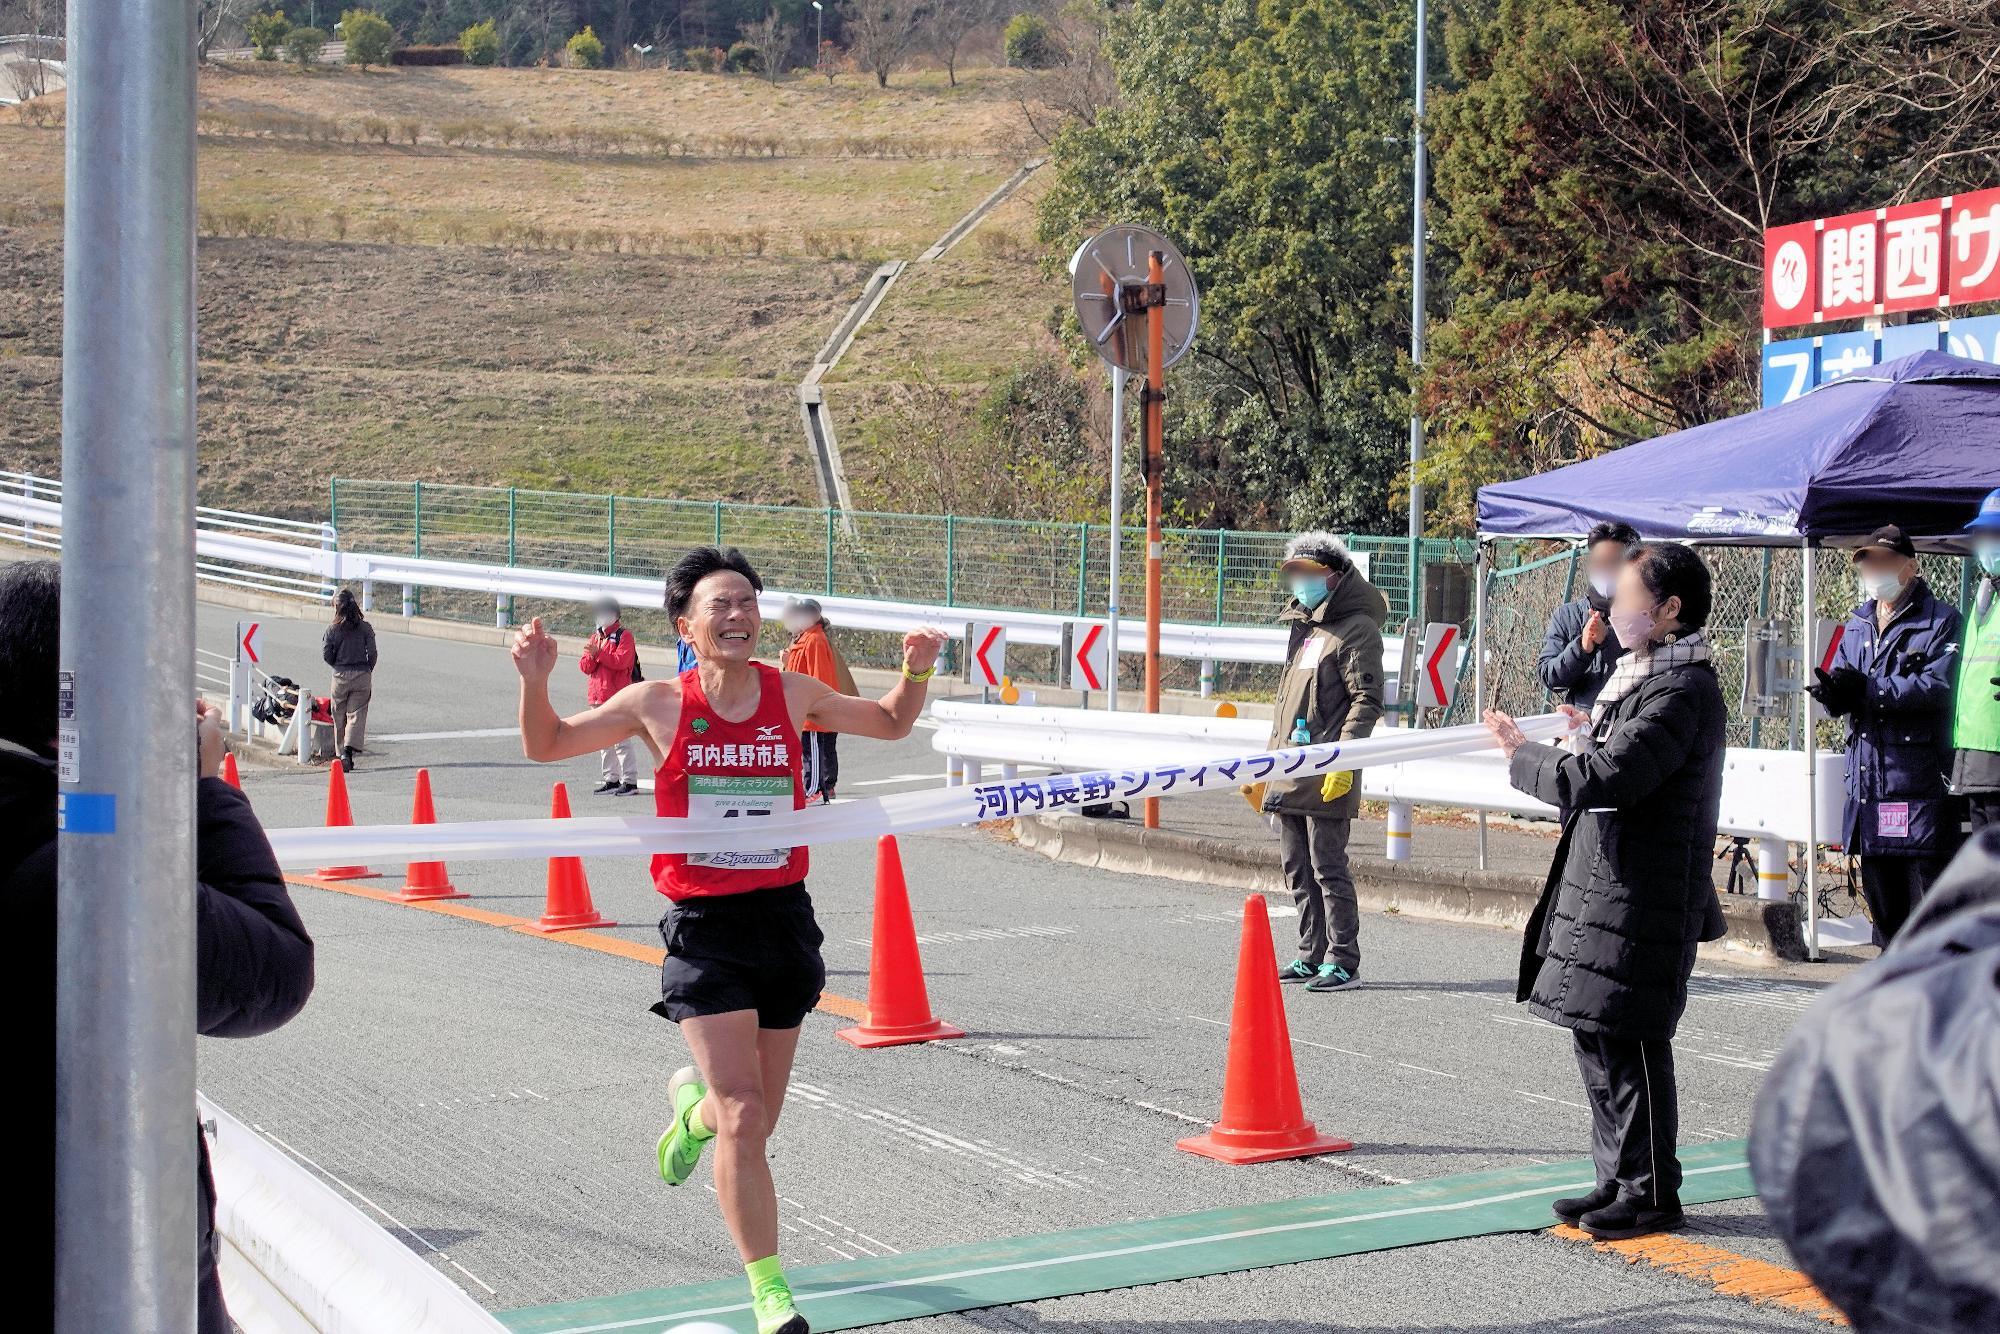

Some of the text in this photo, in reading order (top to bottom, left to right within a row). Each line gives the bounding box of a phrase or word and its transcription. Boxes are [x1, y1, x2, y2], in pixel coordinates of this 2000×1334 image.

[1822, 203, 2000, 308] 関西サ
[687, 744, 789, 767] 河内長野市長
[695, 777, 789, 788] 河内長野シティマラソン大会
[974, 745, 1341, 819] 河内長野シティマラソン
[715, 799, 730, 807] give
[737, 799, 774, 808] challenge
[1880, 811, 1908, 826] STAFF
